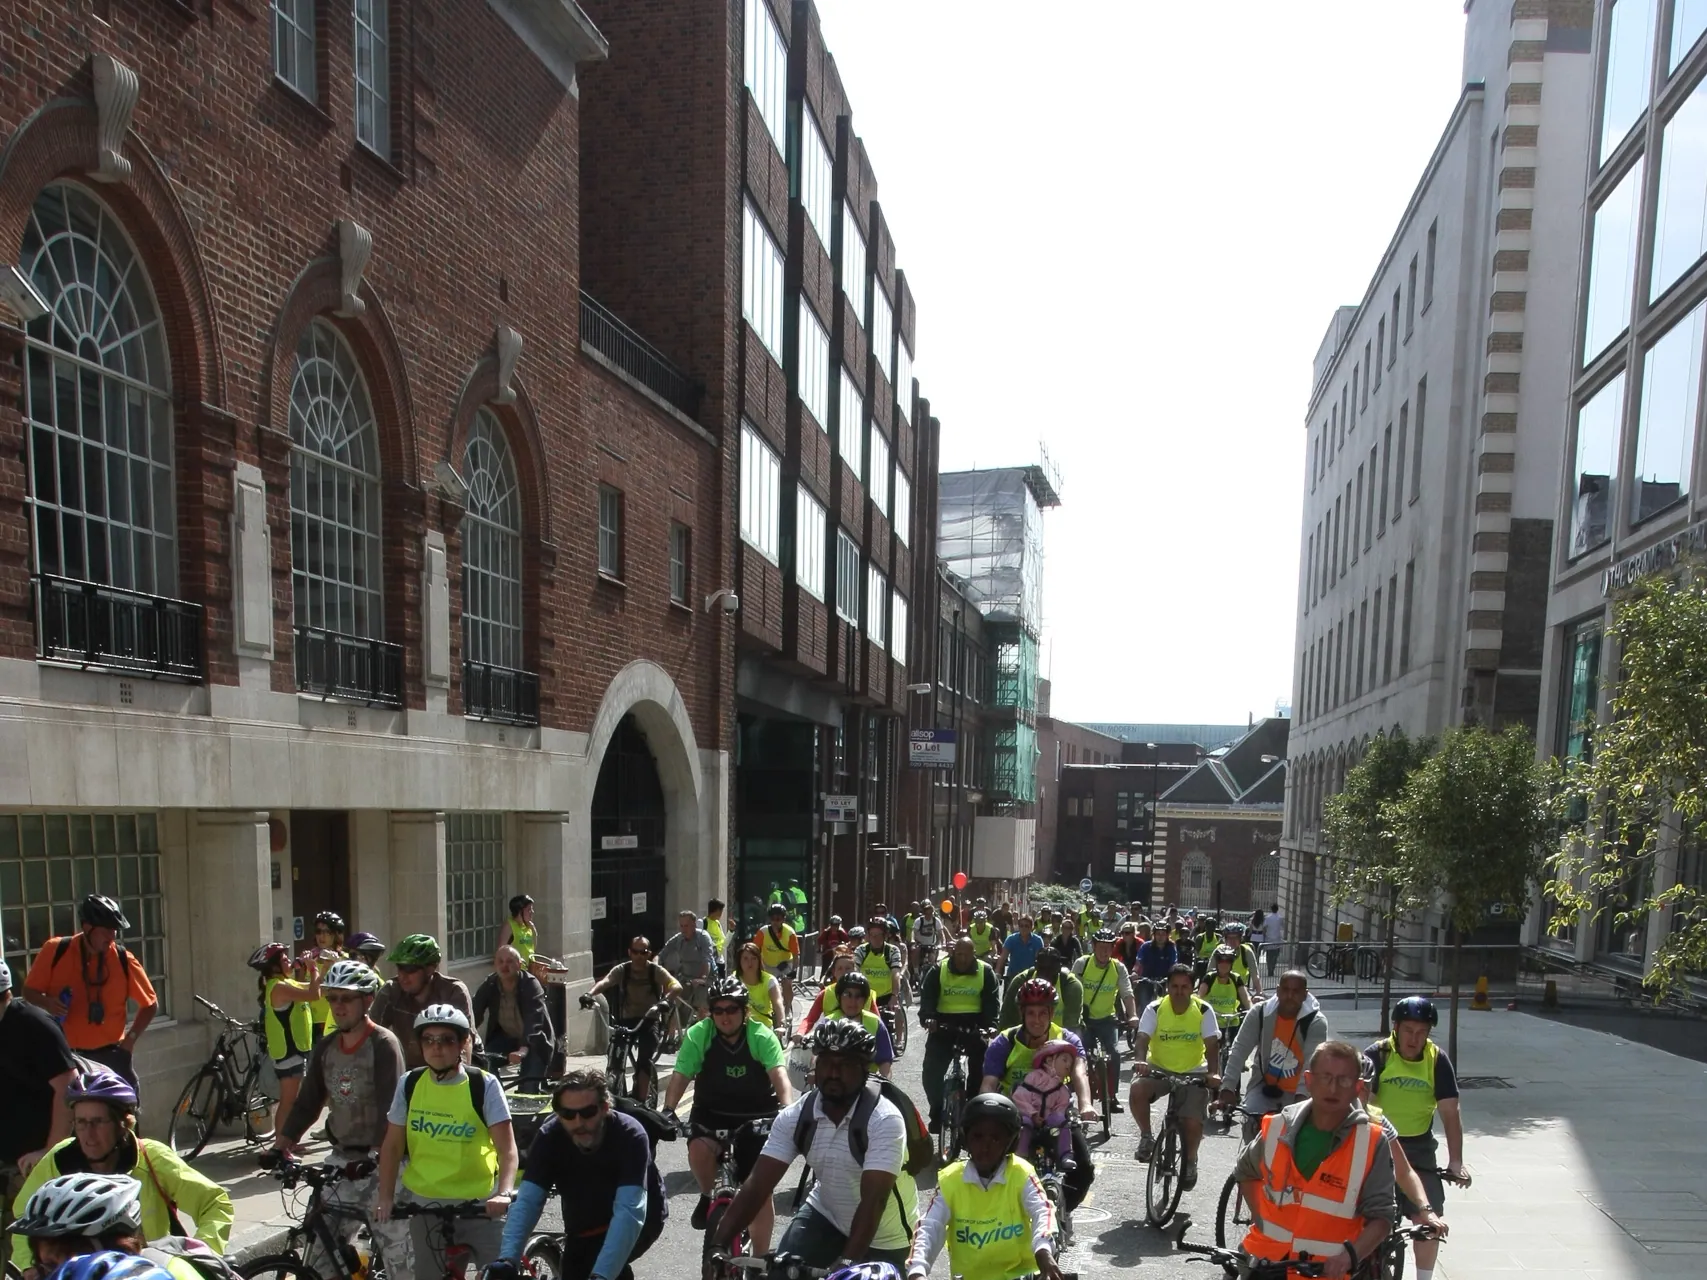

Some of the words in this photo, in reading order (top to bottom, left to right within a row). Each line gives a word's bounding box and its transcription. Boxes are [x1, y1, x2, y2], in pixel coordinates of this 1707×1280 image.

[911, 729, 935, 741] allsop
[911, 742, 923, 751] To
[925, 743, 941, 752] Let
[410, 1115, 477, 1138] skyride
[955, 1221, 1024, 1250] skyride
